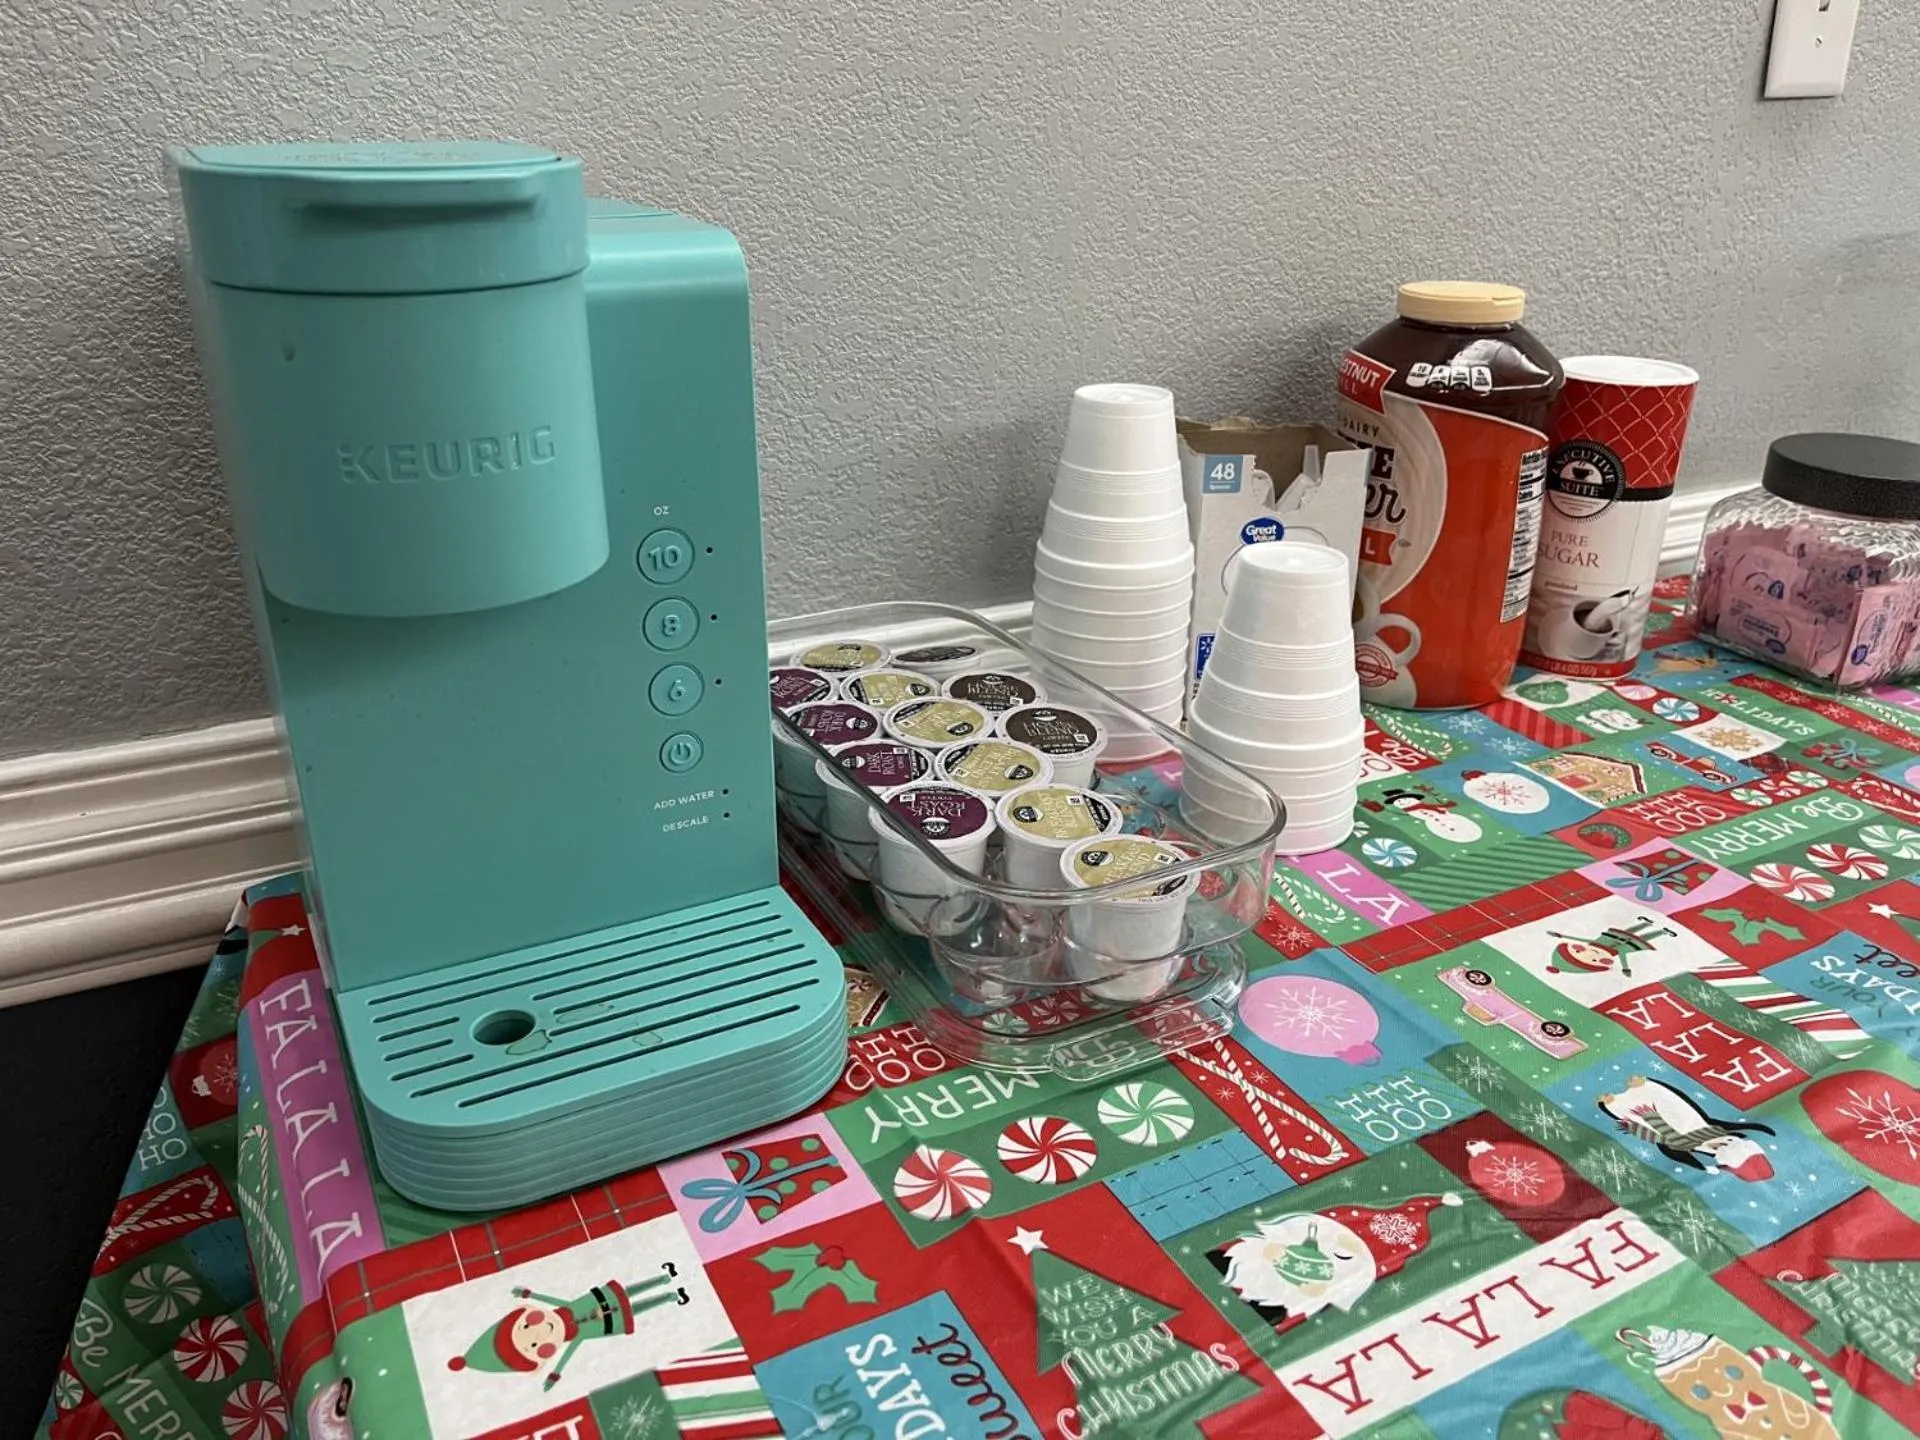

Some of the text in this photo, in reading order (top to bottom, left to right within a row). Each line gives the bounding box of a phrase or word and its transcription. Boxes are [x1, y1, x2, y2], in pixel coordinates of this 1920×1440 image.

[1339, 358, 1381, 389] STNUT
[337, 424, 557, 485] KEURIG
[1210, 462, 1236, 481] 48
[1560, 481, 1600, 498] SUITE
[653, 505, 670, 516] OZ
[1246, 524, 1277, 536] Great
[647, 544, 682, 573] 10
[1538, 542, 1601, 569] SUGAR
[1551, 530, 1589, 547] PURE
[662, 614, 680, 637] 8
[668, 680, 687, 703] 6
[654, 790, 715, 810] ADD WATER
[662, 816, 710, 832] DESCALE
[1690, 812, 1809, 860] MERRY
[1316, 862, 1410, 926] LA
[1853, 944, 1920, 978] eet
[1606, 991, 1696, 1030] LA
[1651, 1021, 1745, 1064] LA
[1701, 1046, 1794, 1094] FA
[864, 1068, 1041, 1144] MERRY
[1362, 1085, 1426, 1131] HO
[1388, 1075, 1453, 1120] HO
[1334, 1094, 1399, 1142] HO
[138, 1137, 187, 1171] HO
[1040, 1273, 1102, 1305] WE
[1041, 1286, 1131, 1326] WISH
[72, 1297, 115, 1369] Be
[1047, 1303, 1159, 1347] YOU A
[1292, 1220, 1661, 1415] FA LA LA
[1060, 1321, 1178, 1390] MERRY
[845, 1332, 956, 1440] DAYS
[911, 1322, 1034, 1440] weet
[1056, 1342, 1241, 1440] CHRISTMAS
